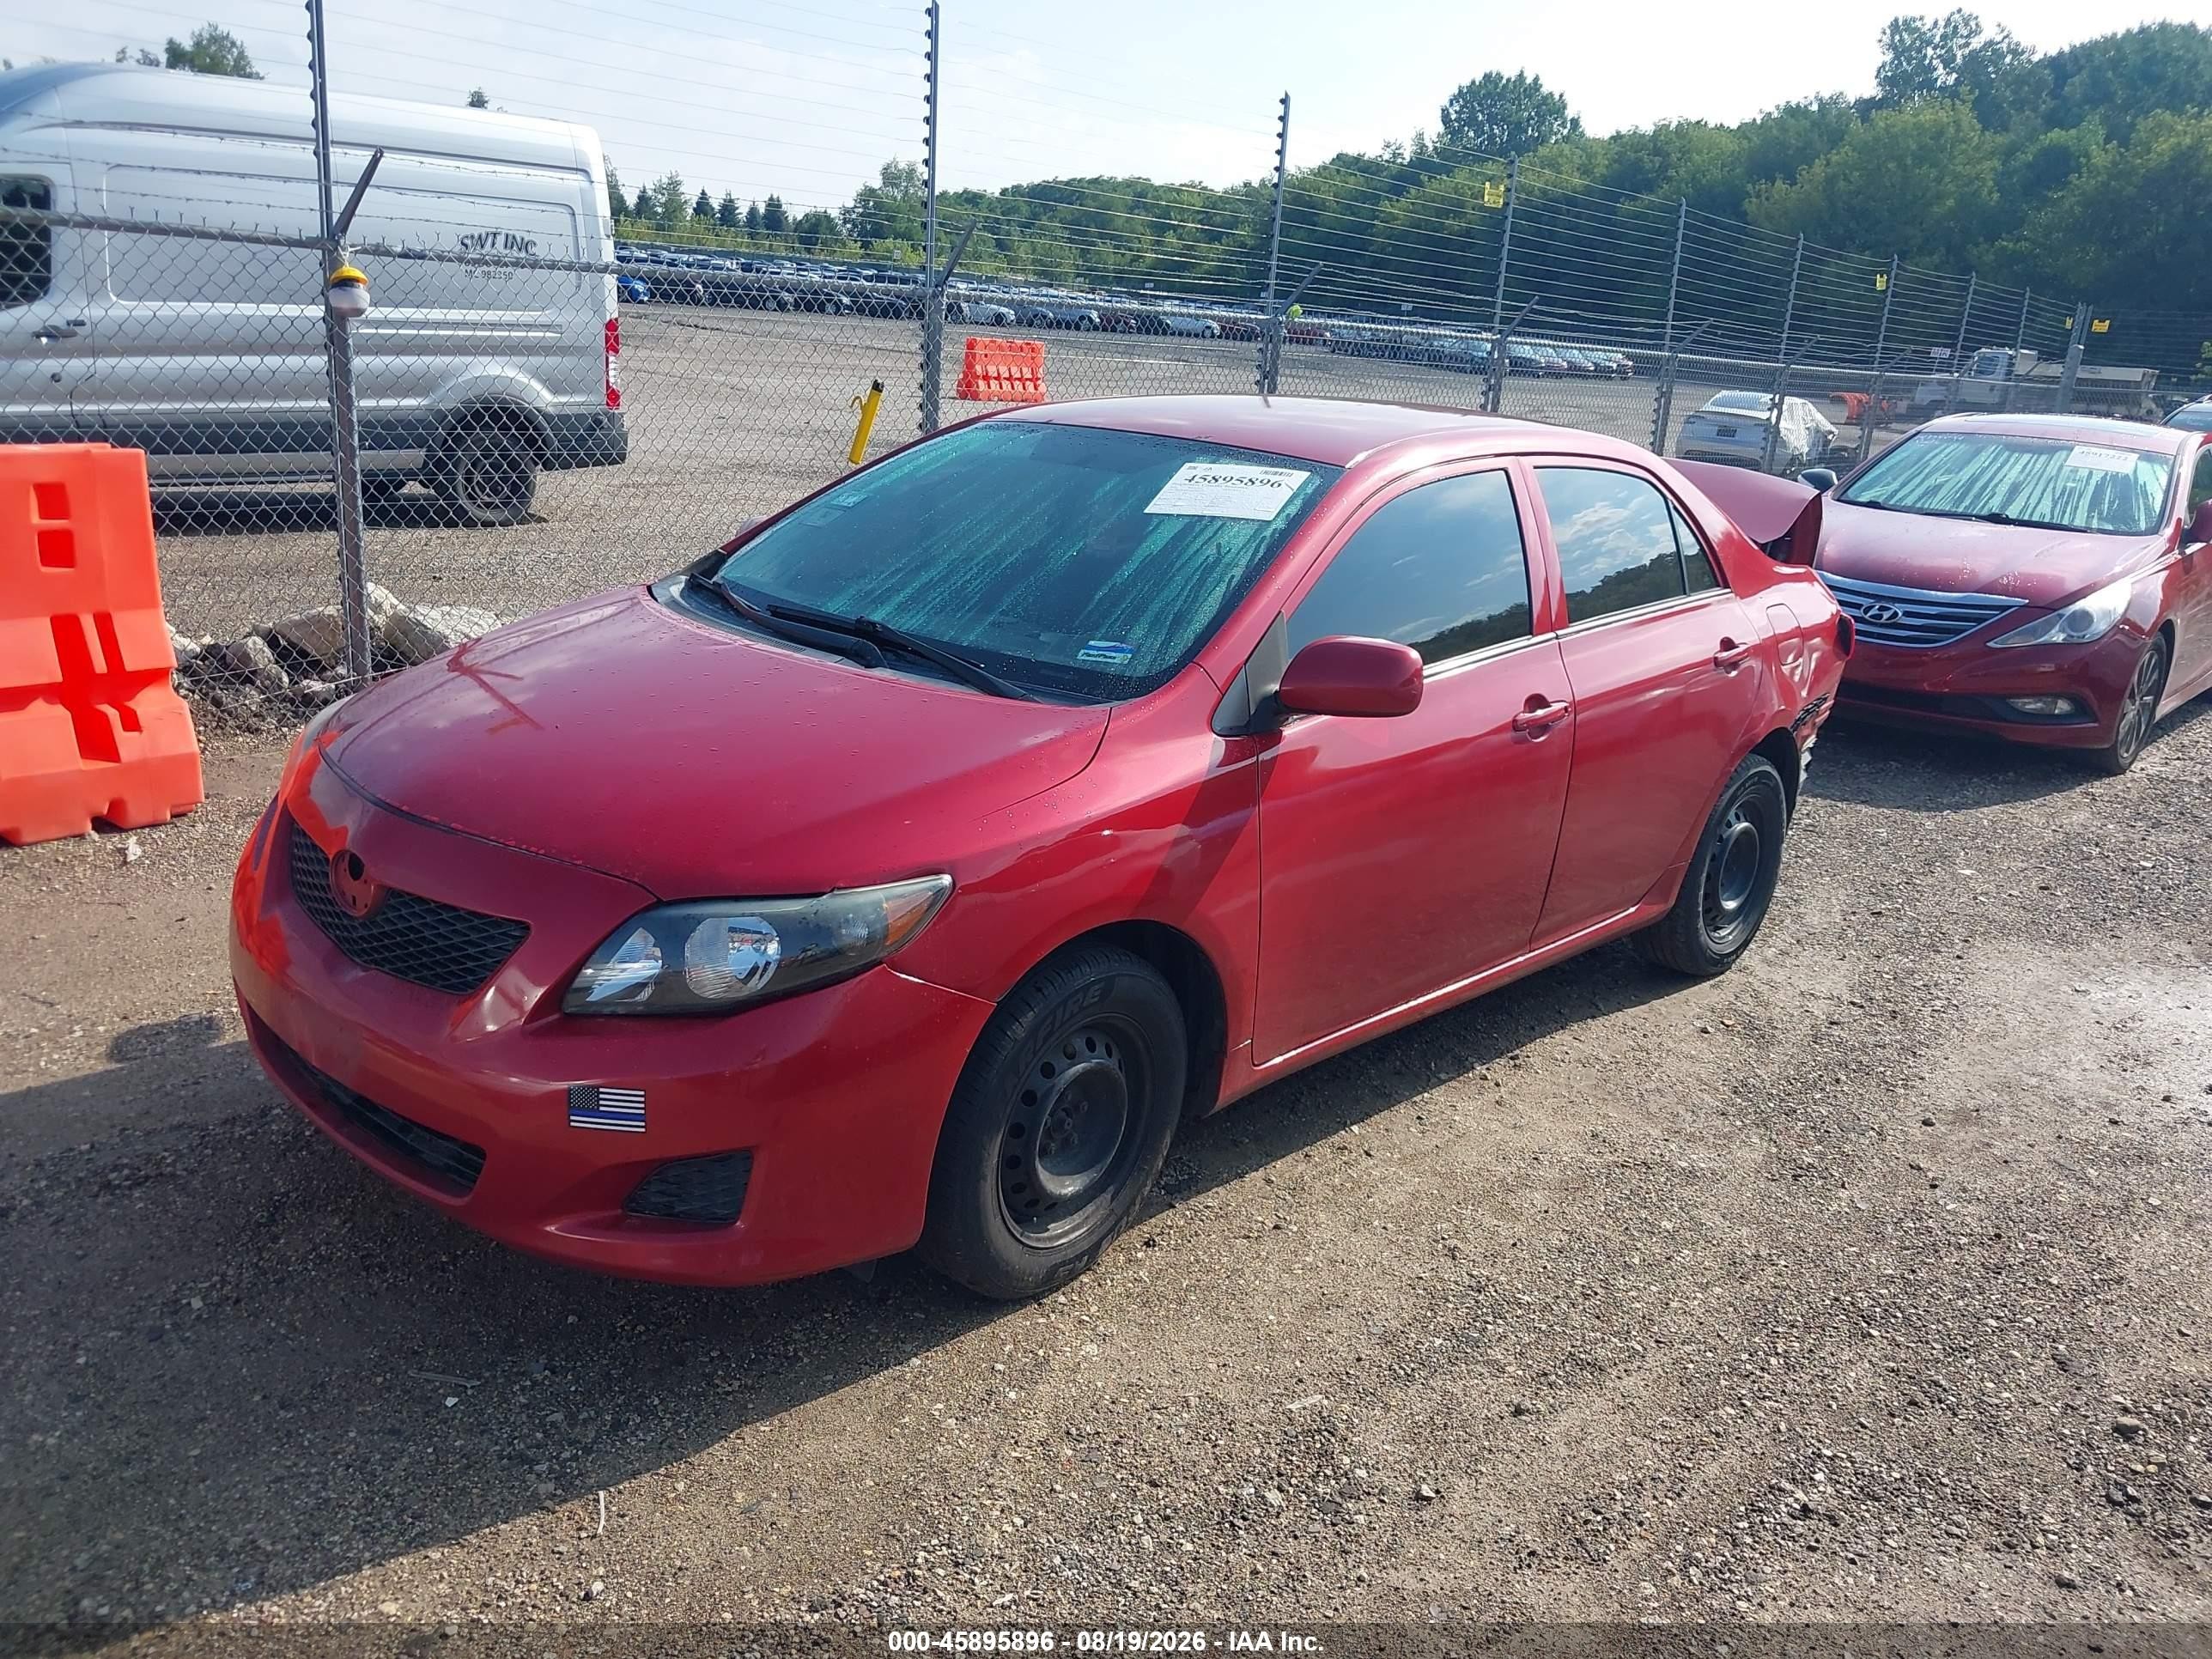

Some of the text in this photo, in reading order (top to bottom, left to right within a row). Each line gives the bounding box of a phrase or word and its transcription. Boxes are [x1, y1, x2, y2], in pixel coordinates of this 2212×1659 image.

[460, 230, 538, 256] SWT INC
[1184, 474, 1285, 489] 45895896
